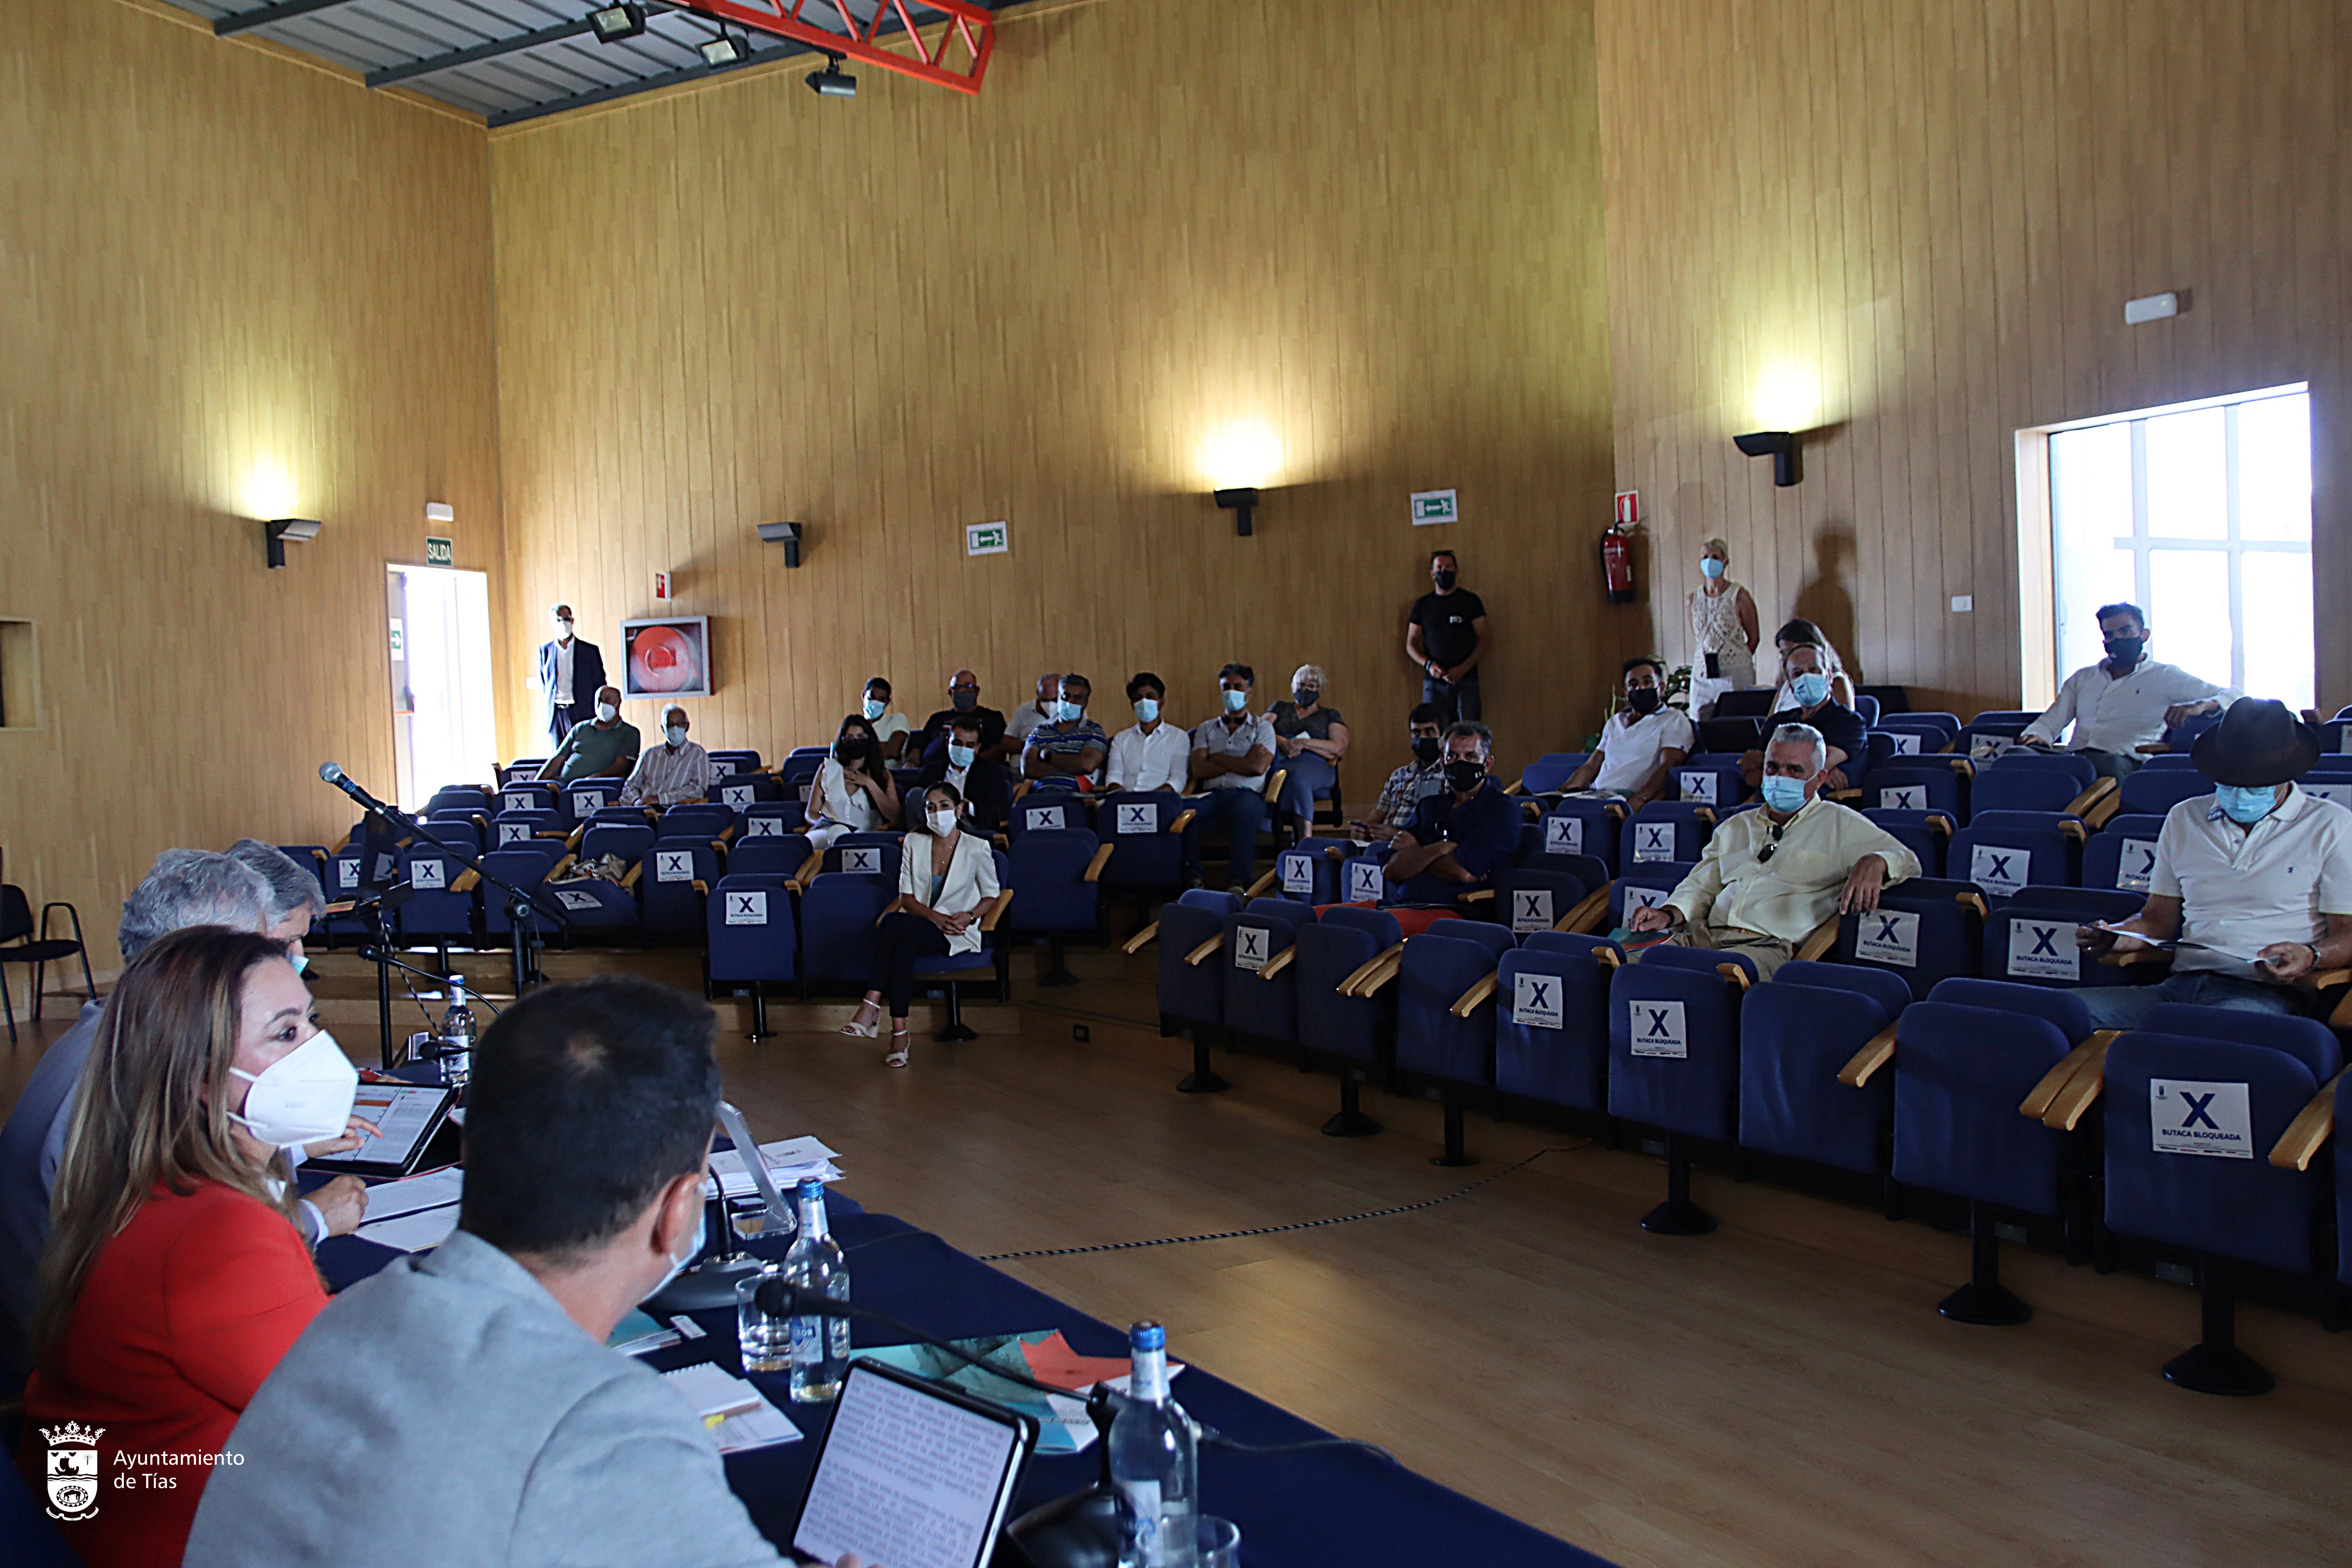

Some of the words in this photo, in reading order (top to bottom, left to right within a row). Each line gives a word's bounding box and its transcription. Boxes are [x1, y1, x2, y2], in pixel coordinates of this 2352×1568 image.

[427, 542, 452, 562] SALIDA
[1692, 777, 1705, 794] X
[584, 795, 595, 808] X
[733, 789, 745, 802] X
[1039, 810, 1054, 825] X
[1130, 807, 1145, 822] X
[1558, 822, 1572, 841] X
[1648, 828, 1663, 848] X
[669, 856, 682, 870] X
[854, 852, 869, 868] X
[1294, 860, 1305, 878] X
[1988, 854, 2011, 880] X
[423, 864, 435, 878] X
[1362, 868, 1373, 889] X
[739, 896, 755, 913] X
[1525, 895, 1542, 917] X
[1876, 915, 1901, 944] X
[1245, 933, 1257, 956] X
[2031, 926, 2058, 956] X
[1529, 981, 1549, 1009] X
[1648, 1008, 1670, 1037] X
[2179, 1091, 2220, 1130] X
[2162, 1129, 2192, 1138] BUTACA
[2193, 1131, 2242, 1142] BLOQUEADA
